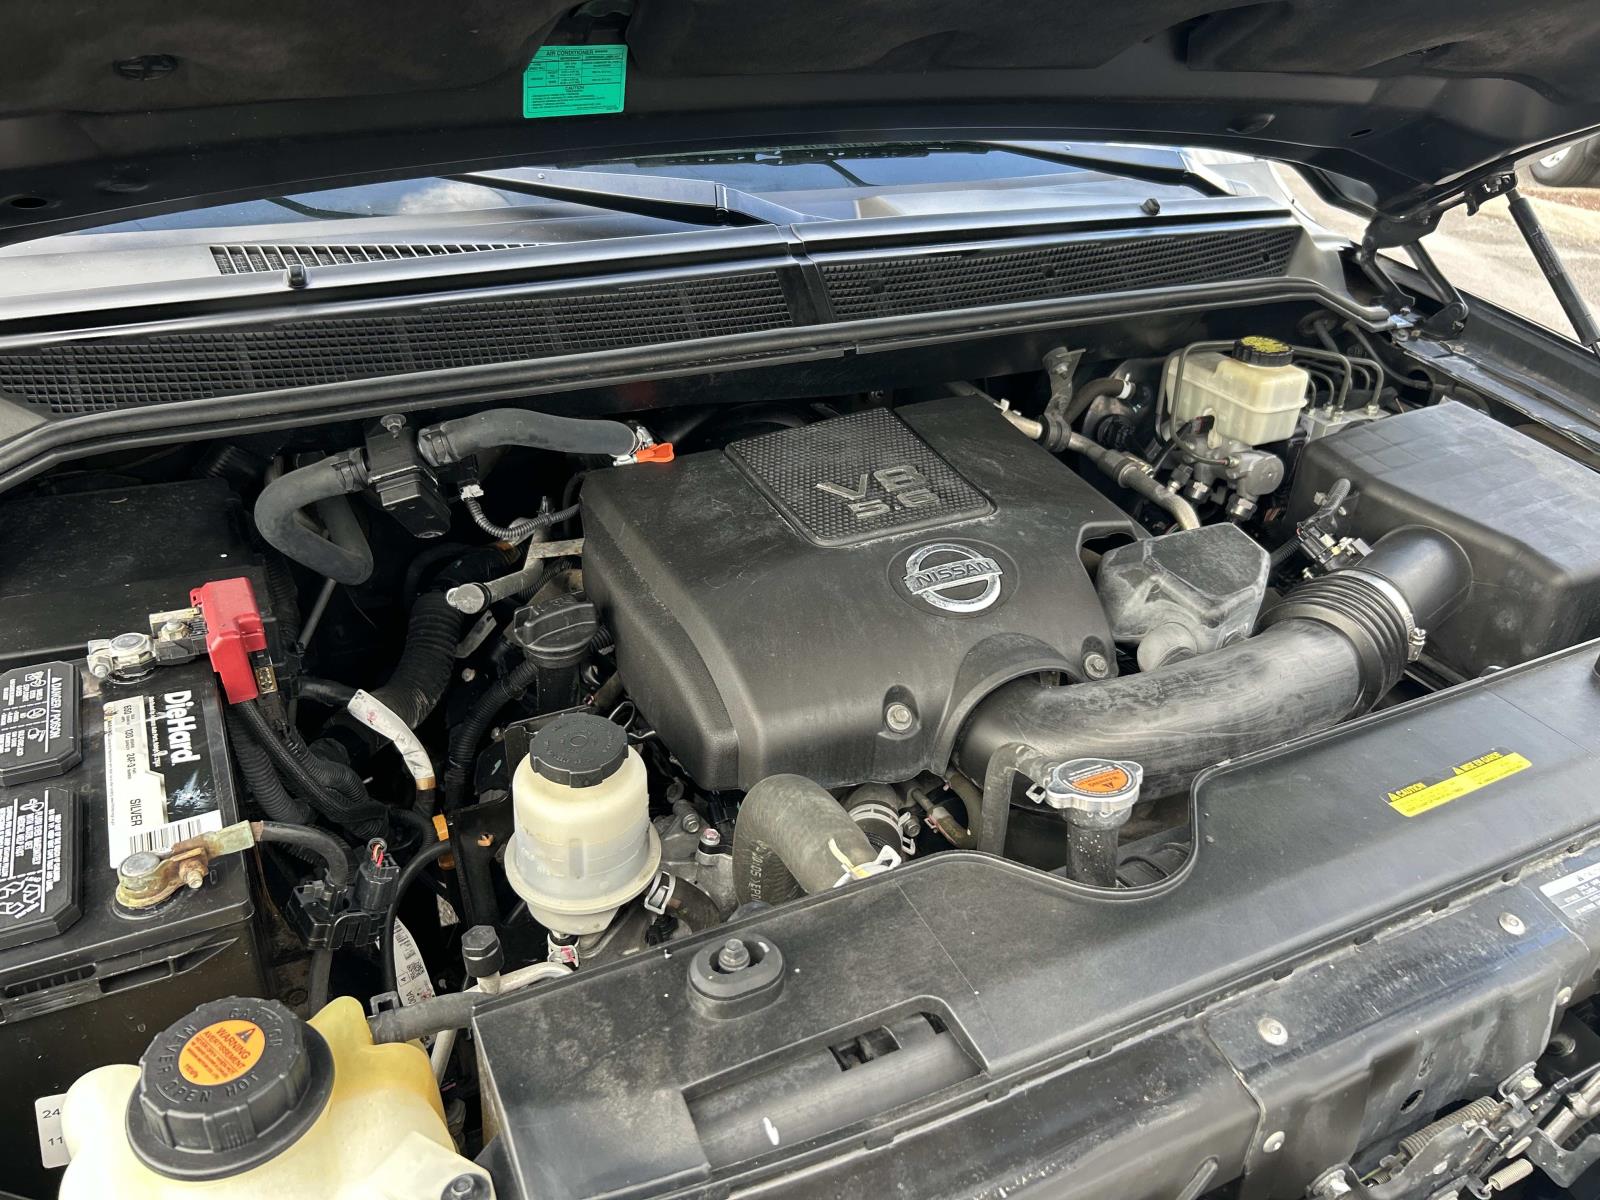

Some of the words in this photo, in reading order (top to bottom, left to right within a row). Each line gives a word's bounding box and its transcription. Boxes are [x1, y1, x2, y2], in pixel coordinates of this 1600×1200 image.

[816, 464, 928, 500] V8
[914, 560, 993, 586] NISSAN
[51, 682, 62, 709] DANGER
[50, 714, 62, 739] POISON
[164, 690, 200, 764] DieHard
[130, 798, 142, 826] SILVER
[202, 1030, 246, 1068] AVERTISSEMENT
[216, 1027, 251, 1060] WARNING
[42, 1108, 61, 1119] 24
[48, 1136, 63, 1146] 11
